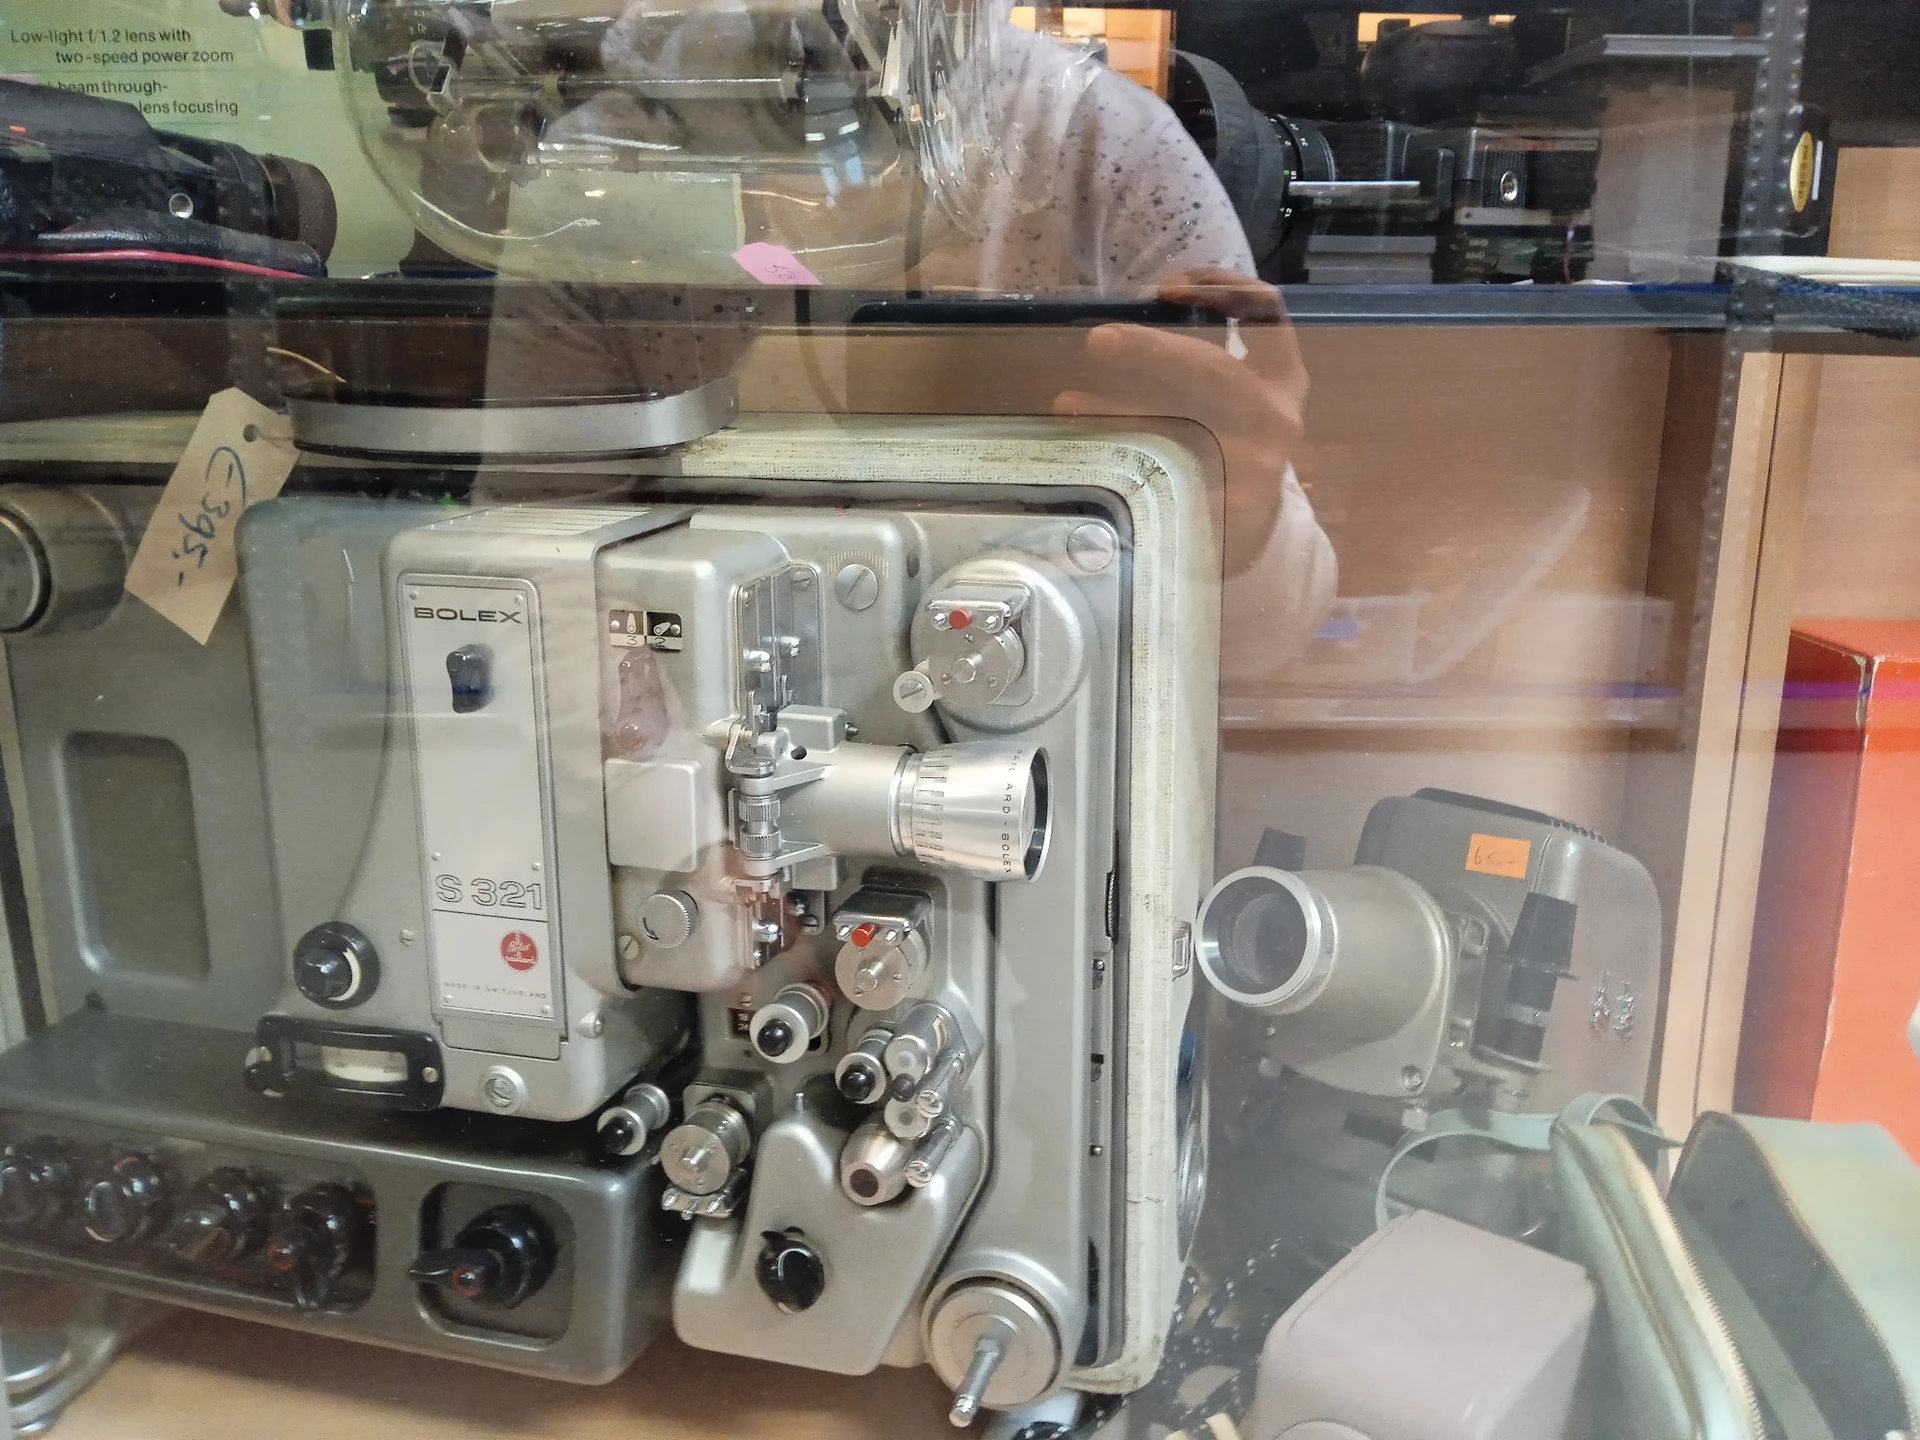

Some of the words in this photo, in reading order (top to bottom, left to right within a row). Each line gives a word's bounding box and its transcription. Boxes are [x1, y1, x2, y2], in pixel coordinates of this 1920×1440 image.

[10, 28, 83, 46] Low-light
[87, 28, 121, 43] f/1.2
[125, 29, 157, 43] lens
[159, 28, 191, 42] with
[56, 50, 138, 66] two-speed
[142, 52, 188, 65] power
[192, 51, 234, 63] zoom
[102, 80, 169, 96] through-
[173, 99, 238, 117] focusing
[413, 606, 524, 625] BOLEX
[626, 634, 638, 646] 3
[654, 636, 666, 648] 2
[435, 873, 463, 903] S
[470, 877, 543, 910] 321
